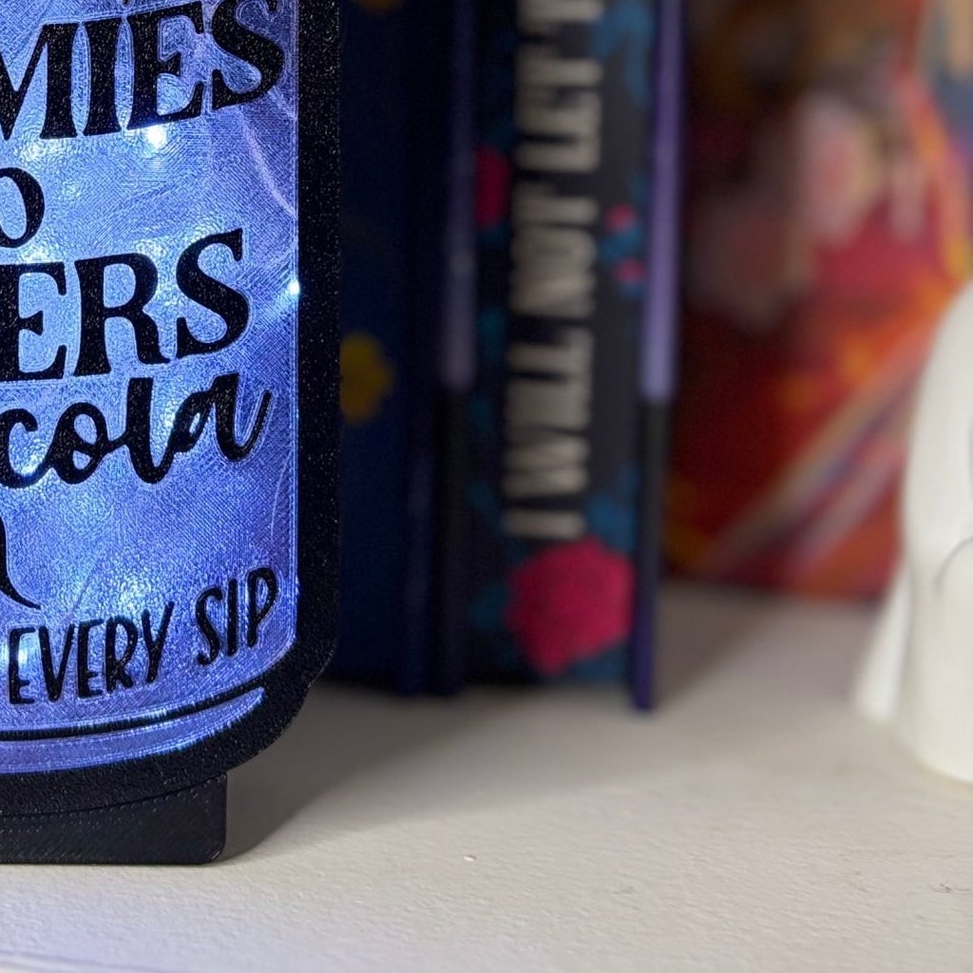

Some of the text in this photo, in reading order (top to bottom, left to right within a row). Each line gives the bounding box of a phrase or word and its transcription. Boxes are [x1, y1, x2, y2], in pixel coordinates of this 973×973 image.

[512, 44, 603, 173] LET
[511, 183, 598, 320] NOT
[503, 327, 594, 498] WILL
[503, 509, 587, 540] I
[8, 602, 175, 705] EVERY
[194, 566, 280, 666] SIP
